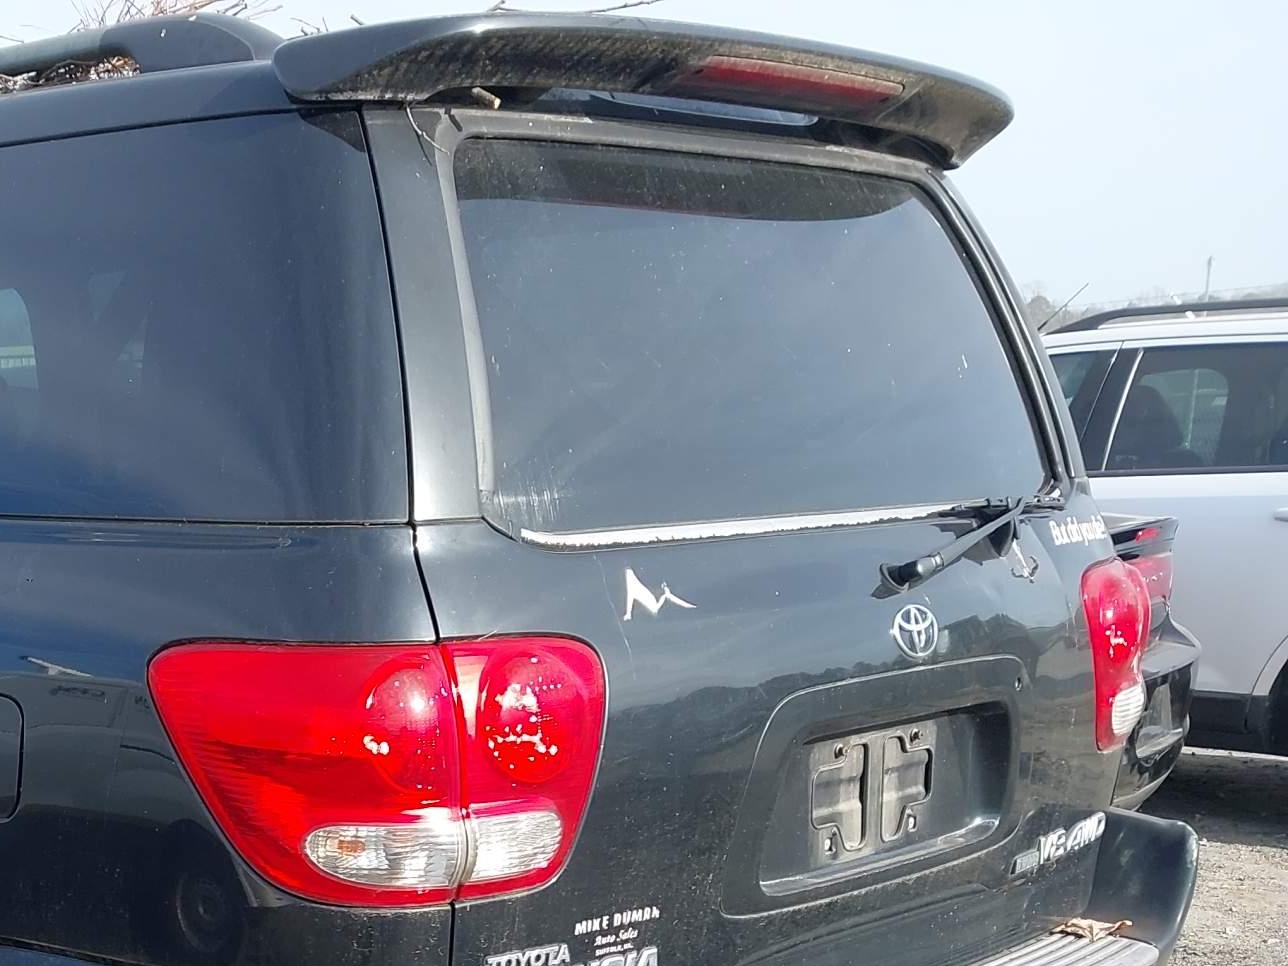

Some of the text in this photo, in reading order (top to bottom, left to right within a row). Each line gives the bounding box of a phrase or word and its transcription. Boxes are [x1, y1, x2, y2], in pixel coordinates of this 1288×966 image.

[1067, 811, 1106, 851] 4WD
[574, 915, 610, 936] MIKE
[616, 927, 639, 942] Sales
